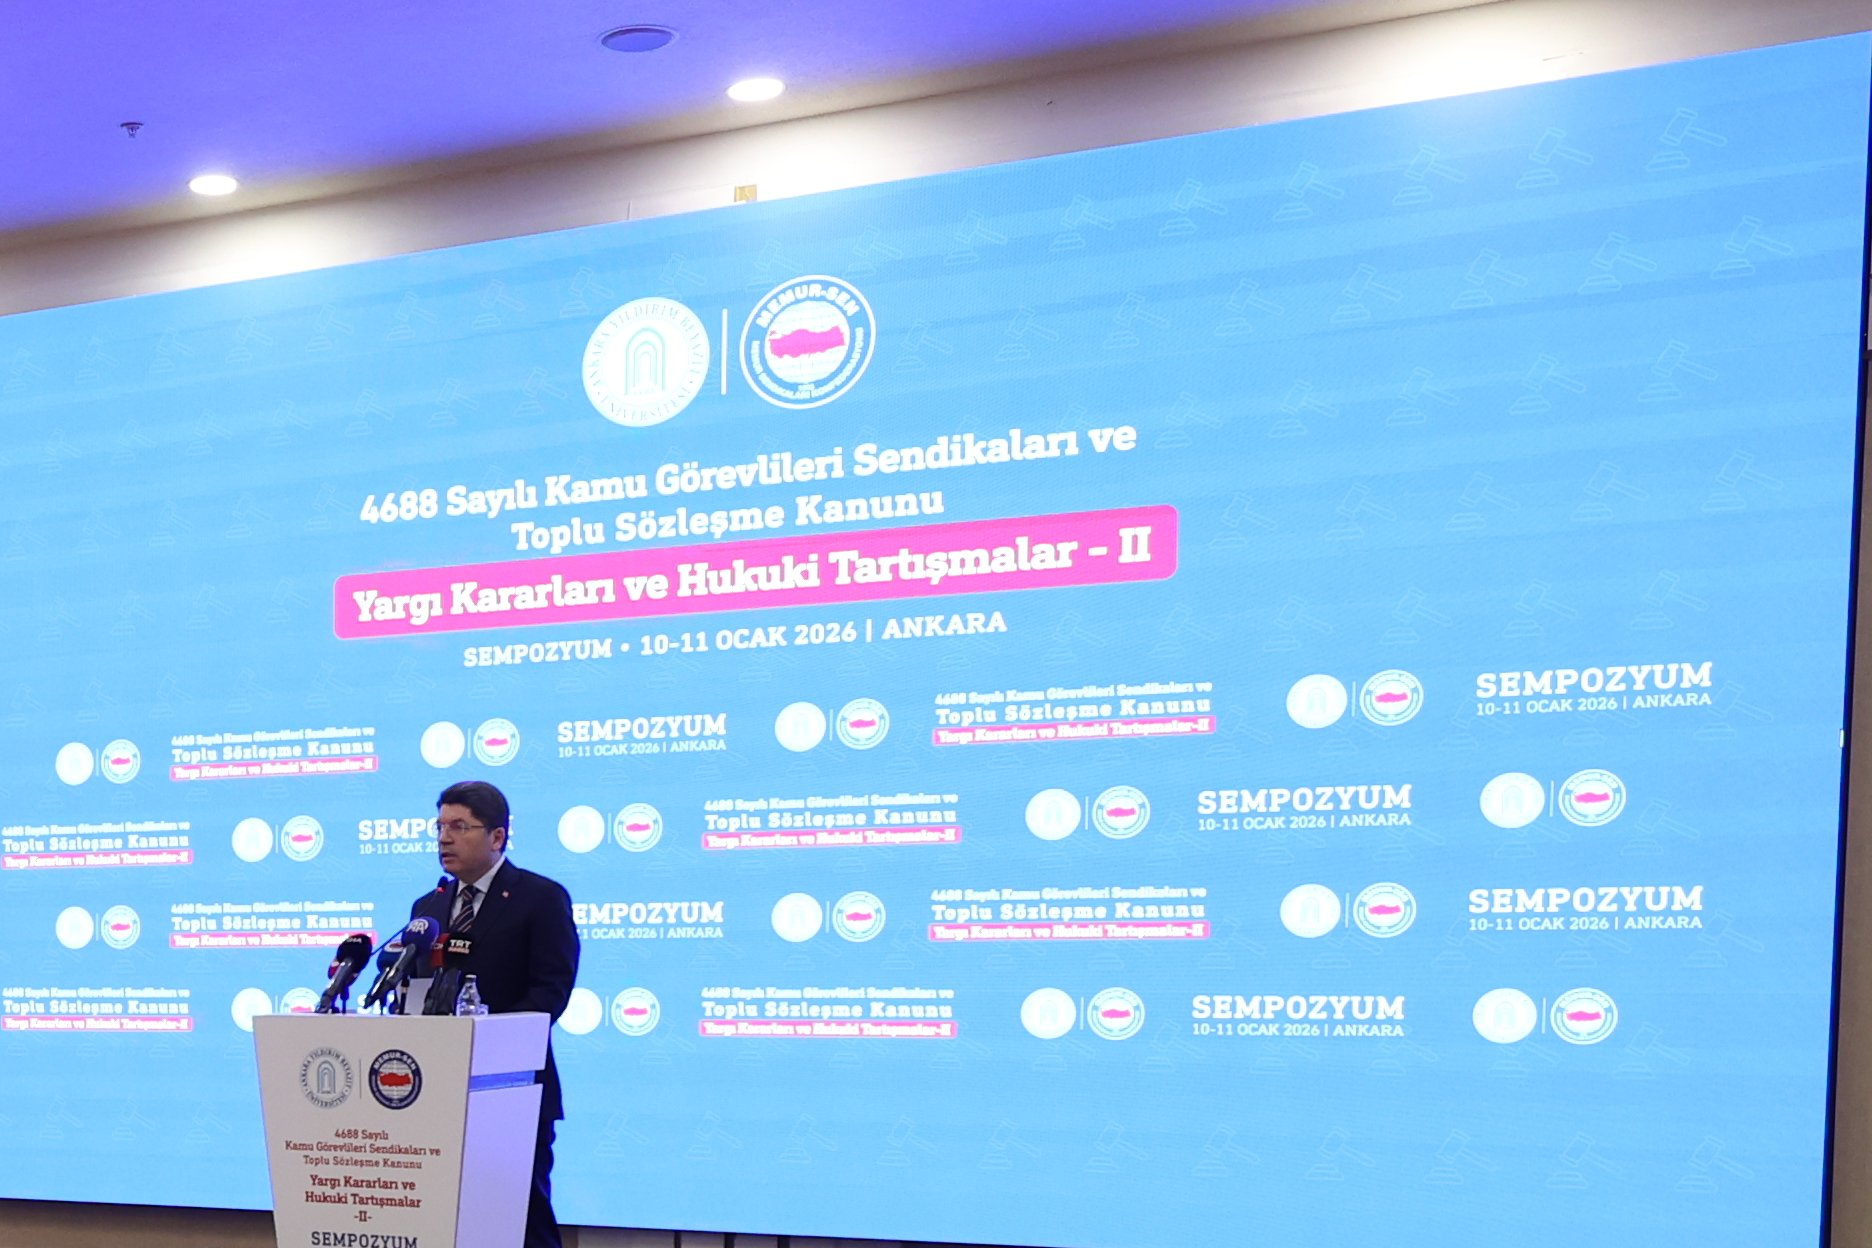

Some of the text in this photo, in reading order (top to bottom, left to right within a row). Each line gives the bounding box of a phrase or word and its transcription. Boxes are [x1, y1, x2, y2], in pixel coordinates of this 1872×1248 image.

[756, 283, 860, 329] MEMUR-SEN
[360, 426, 1137, 522] 4688 Sayılı Kamu Görevlileri Sendikaları ve
[510, 491, 945, 554] Toplu Sözleşme Kanunu
[353, 590, 442, 625] Yargı
[450, 575, 615, 614] Kararları
[623, 574, 668, 600] ve
[677, 554, 820, 596] Hukuki
[828, 537, 1078, 584] Tartışmalar
[1119, 526, 1151, 563] II
[463, 612, 1008, 666] SEMPOZYUM 10-11 OCAK 2026 ANKARA
[1475, 663, 1713, 697] SEMPOZYUM
[935, 699, 1211, 729] Toplu Sözleşme Kanunu
[1476, 693, 1713, 715] 10-11 OCAK 2026 ANKARA
[557, 714, 727, 742] SEMPOZYUM
[171, 742, 374, 765] Toplu Sözleşme Kanunu
[558, 739, 726, 757] 10-11 OCAK 2026 ANKARA
[1196, 785, 1412, 813] SEMPOZYUM
[704, 810, 957, 834] Toplu Sözleşme Kanunu
[1198, 813, 1413, 830] 10-11 OCAK 2026 ANKARA
[2, 834, 189, 855] Toplu Sözleşme Kanunu
[359, 843, 389, 854] 10-11
[392, 842, 423, 853] OCAK
[1468, 886, 1704, 913] SEMPOZYUM
[572, 901, 724, 924] EMPOZYUM
[930, 902, 1206, 924] Toplu Sözleşme Kanunu
[171, 914, 373, 934] Toplu Sözleşme Kanunu
[592, 927, 624, 939] OCAK
[628, 927, 656, 938] 2026
[667, 926, 723, 938] ANKARA
[1469, 916, 1703, 931] 10-11 OCAK 2026 ANKARA
[449, 939, 472, 948] TRT
[2, 999, 189, 1017] Toplu Sözleşme Kanunu
[701, 1001, 953, 1021] Toplu Sözleşme Kanunu
[1191, 995, 1405, 1019] SEMPOZYUM
[1192, 1023, 1405, 1036] 10-11 OCAK 2026 ANKARA
[334, 1128, 389, 1141] 4688 Sayılı
[285, 1140, 441, 1156] Kamu Görevlileri Sendikaları ve
[302, 1155, 422, 1169] Toplu Sözleşme Kanunu
[310, 1174, 416, 1191] Yargı Kararları ve
[304, 1191, 422, 1208] Hukuki Tartışmalar
